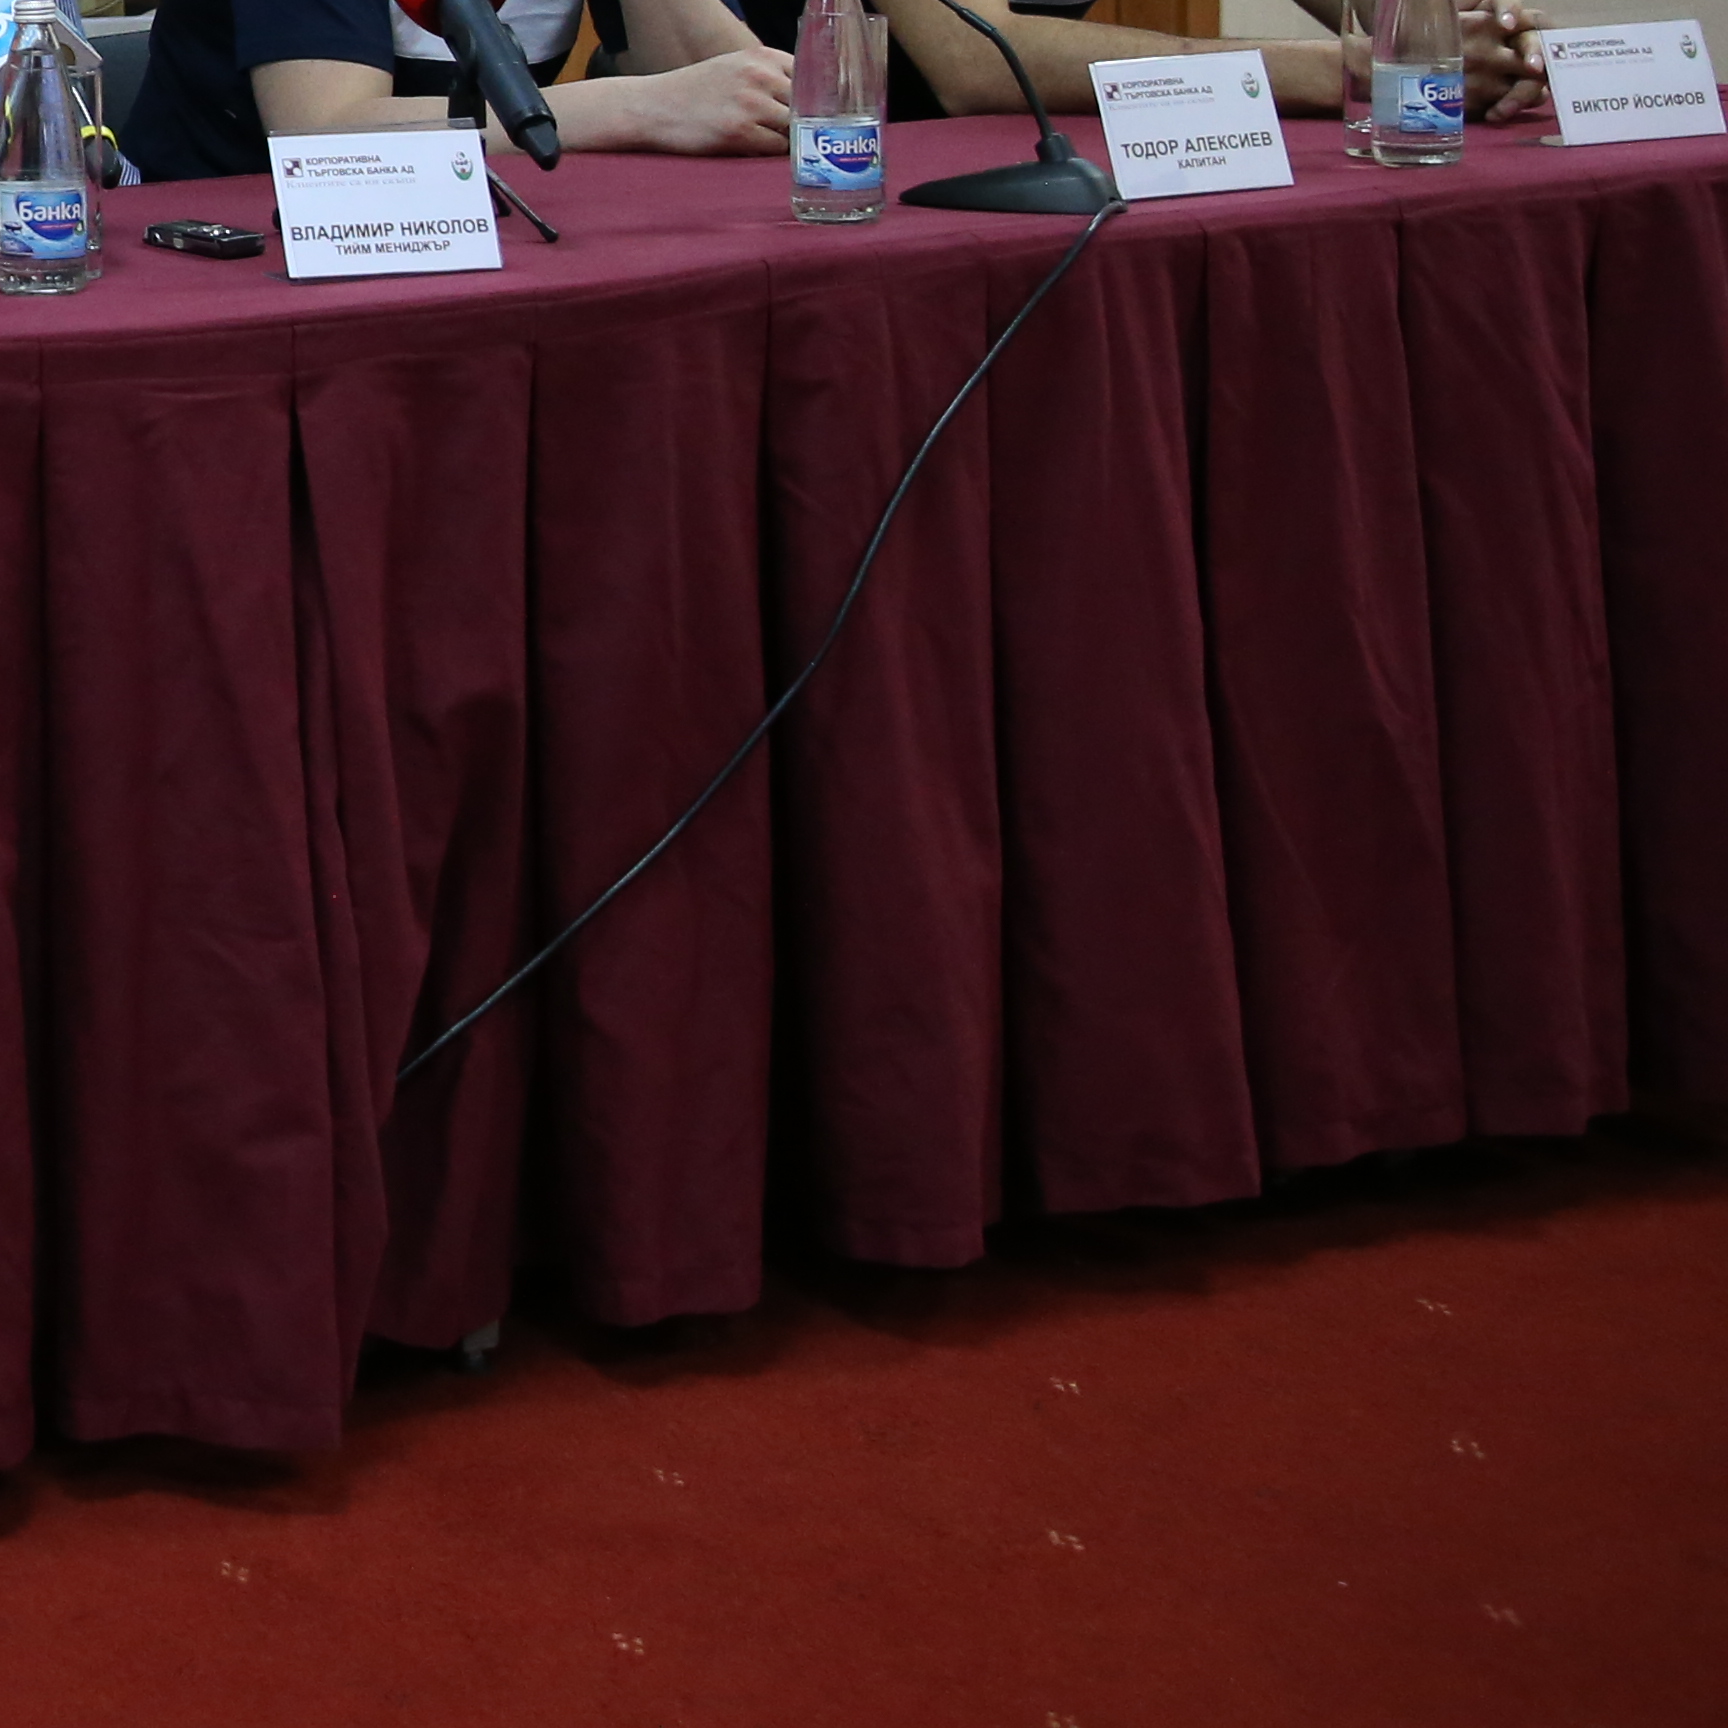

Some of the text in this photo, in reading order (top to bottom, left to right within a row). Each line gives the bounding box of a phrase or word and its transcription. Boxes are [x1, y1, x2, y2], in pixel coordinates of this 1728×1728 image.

[1572, 92, 1705, 114] ВИКТОР ЙОСИФОВ
[1121, 131, 1273, 159] ТОДОР АЛЕКСИЕВ
[305, 155, 381, 166] КОРПОРАТИВНА
[1178, 157, 1227, 170] КАПИТАН
[307, 165, 415, 177] ТЪРГОВСКА БАНКА АД
[291, 219, 489, 242] ВЛАДИМИР НИКОЛОВ
[335, 240, 451, 256] ТИЙМ МЕНИДЖЪР
